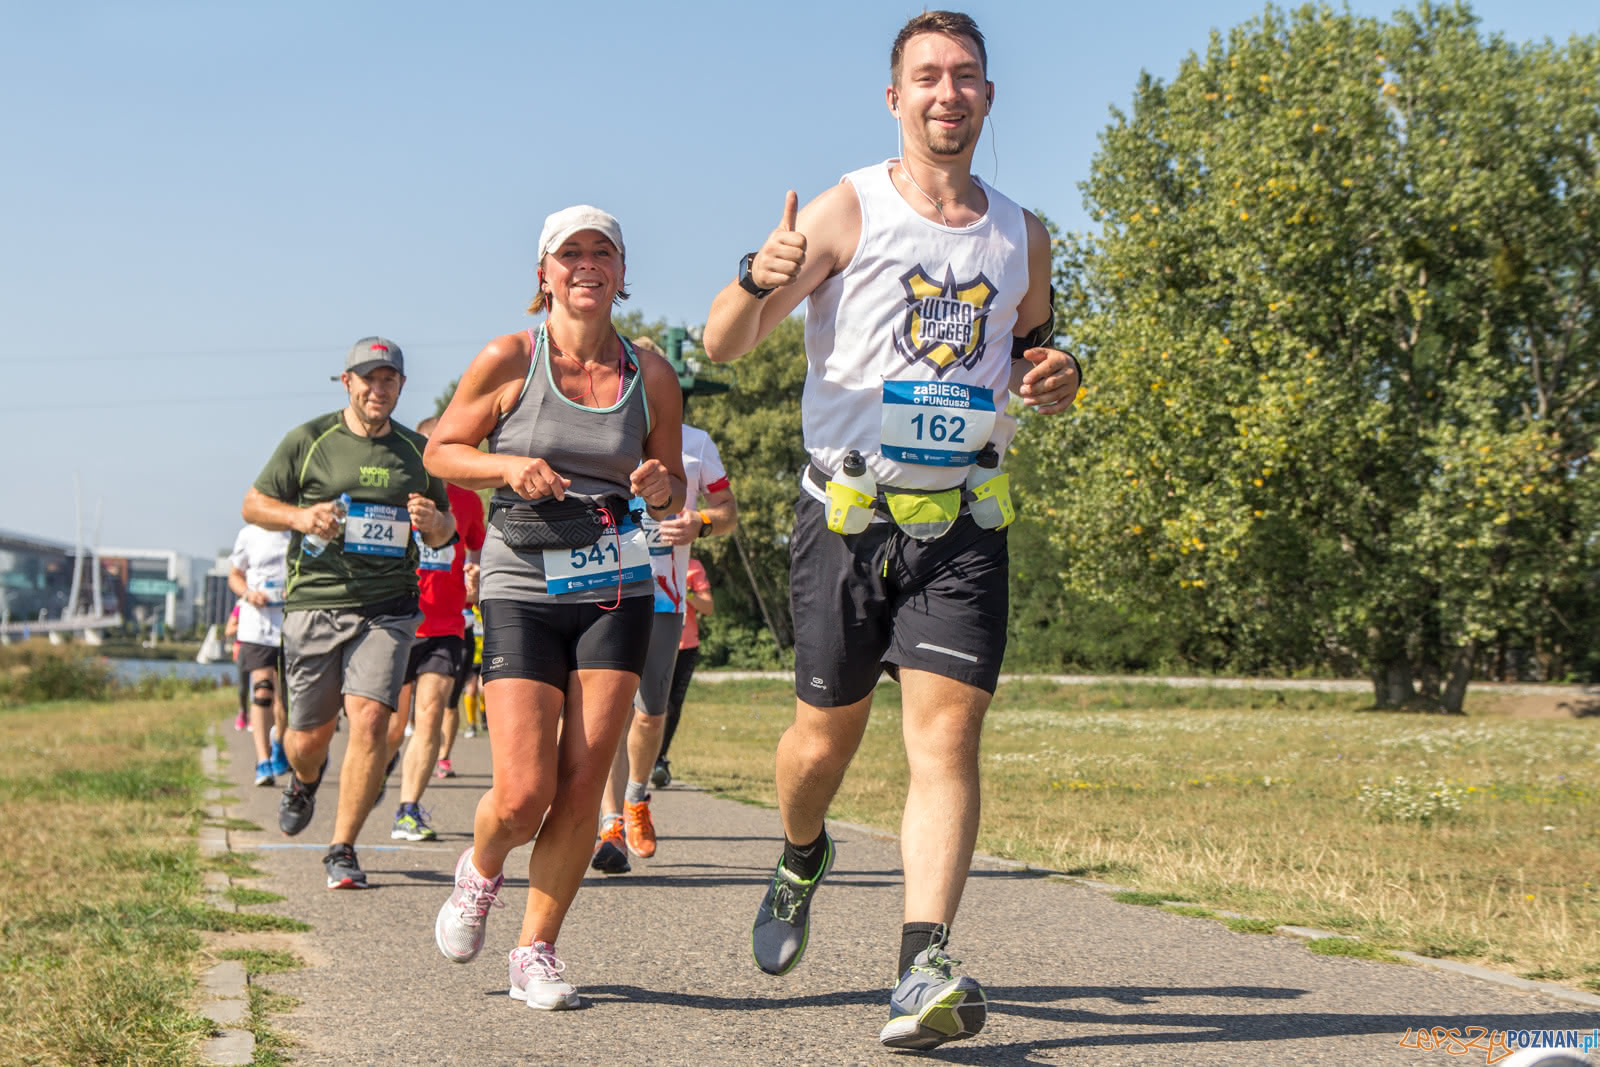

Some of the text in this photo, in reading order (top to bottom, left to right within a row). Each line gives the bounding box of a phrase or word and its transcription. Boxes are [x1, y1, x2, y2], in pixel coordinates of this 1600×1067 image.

[923, 298, 972, 324] ULTRA
[920, 320, 971, 343] JOGGER
[913, 383, 970, 400] zaBIEGaj
[922, 396, 970, 408] FUNdusze
[911, 413, 966, 443] 162
[360, 466, 389, 475] WORK
[359, 474, 389, 488] OUT
[362, 523, 394, 541] 224
[570, 542, 619, 569] 541
